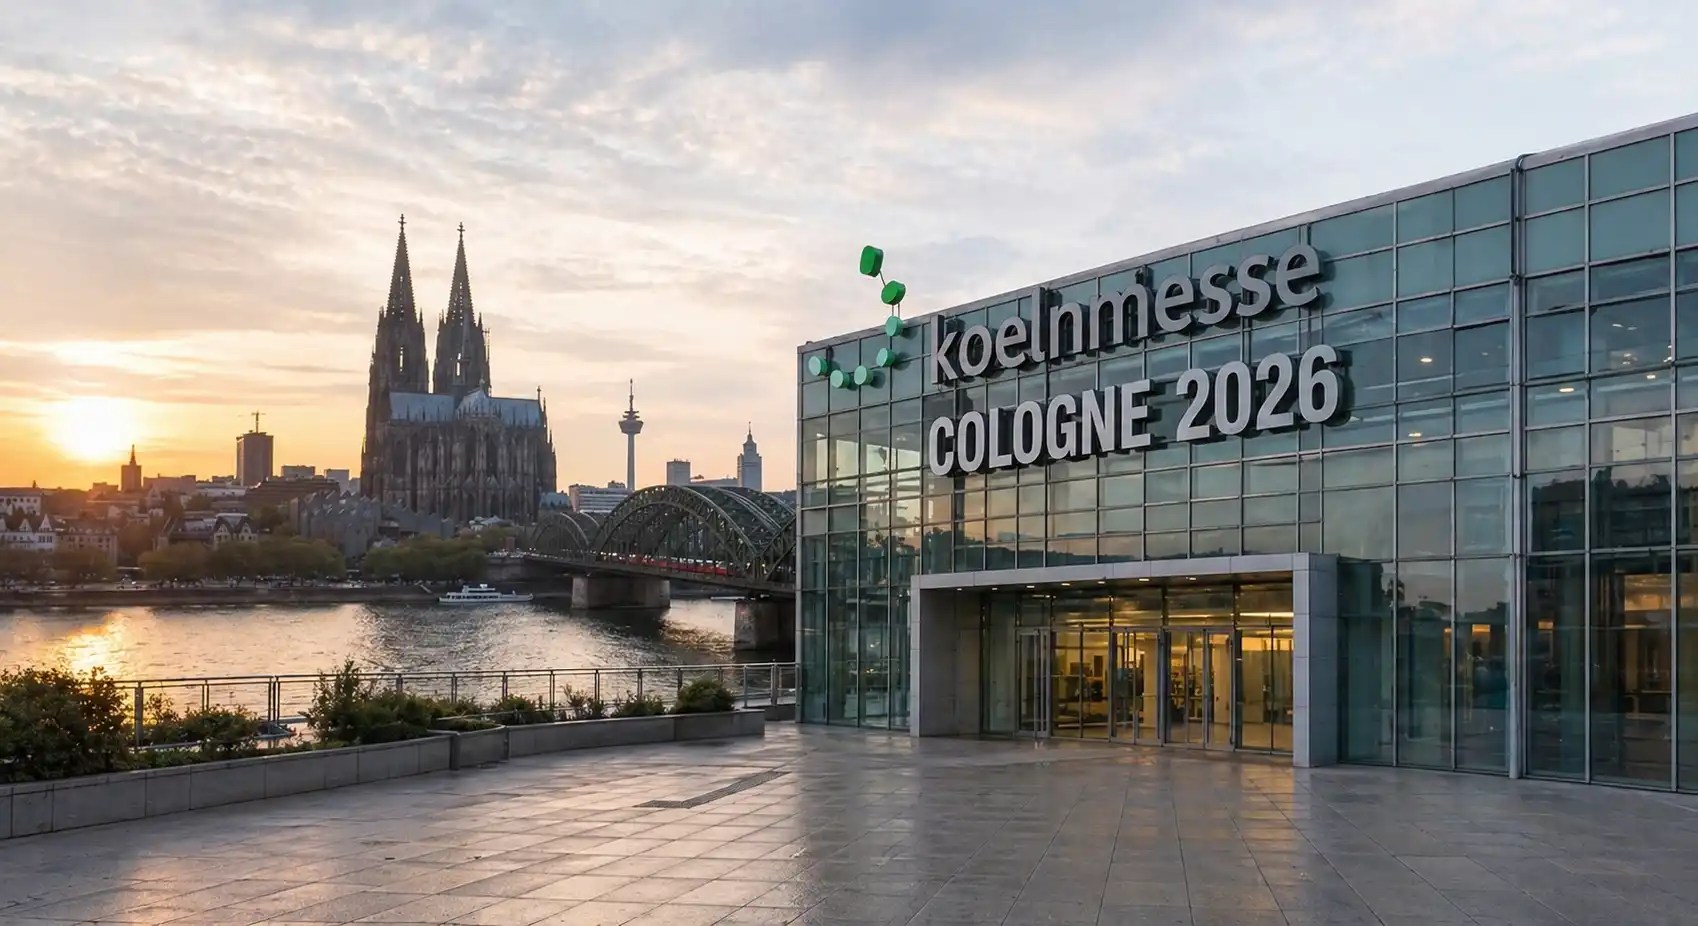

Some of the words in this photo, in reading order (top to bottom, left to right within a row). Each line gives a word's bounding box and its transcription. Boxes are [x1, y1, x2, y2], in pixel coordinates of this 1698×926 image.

[931, 244, 1322, 385] koelnmesse
[928, 378, 1152, 477] COLOGNE
[1176, 344, 1341, 443] 2026
